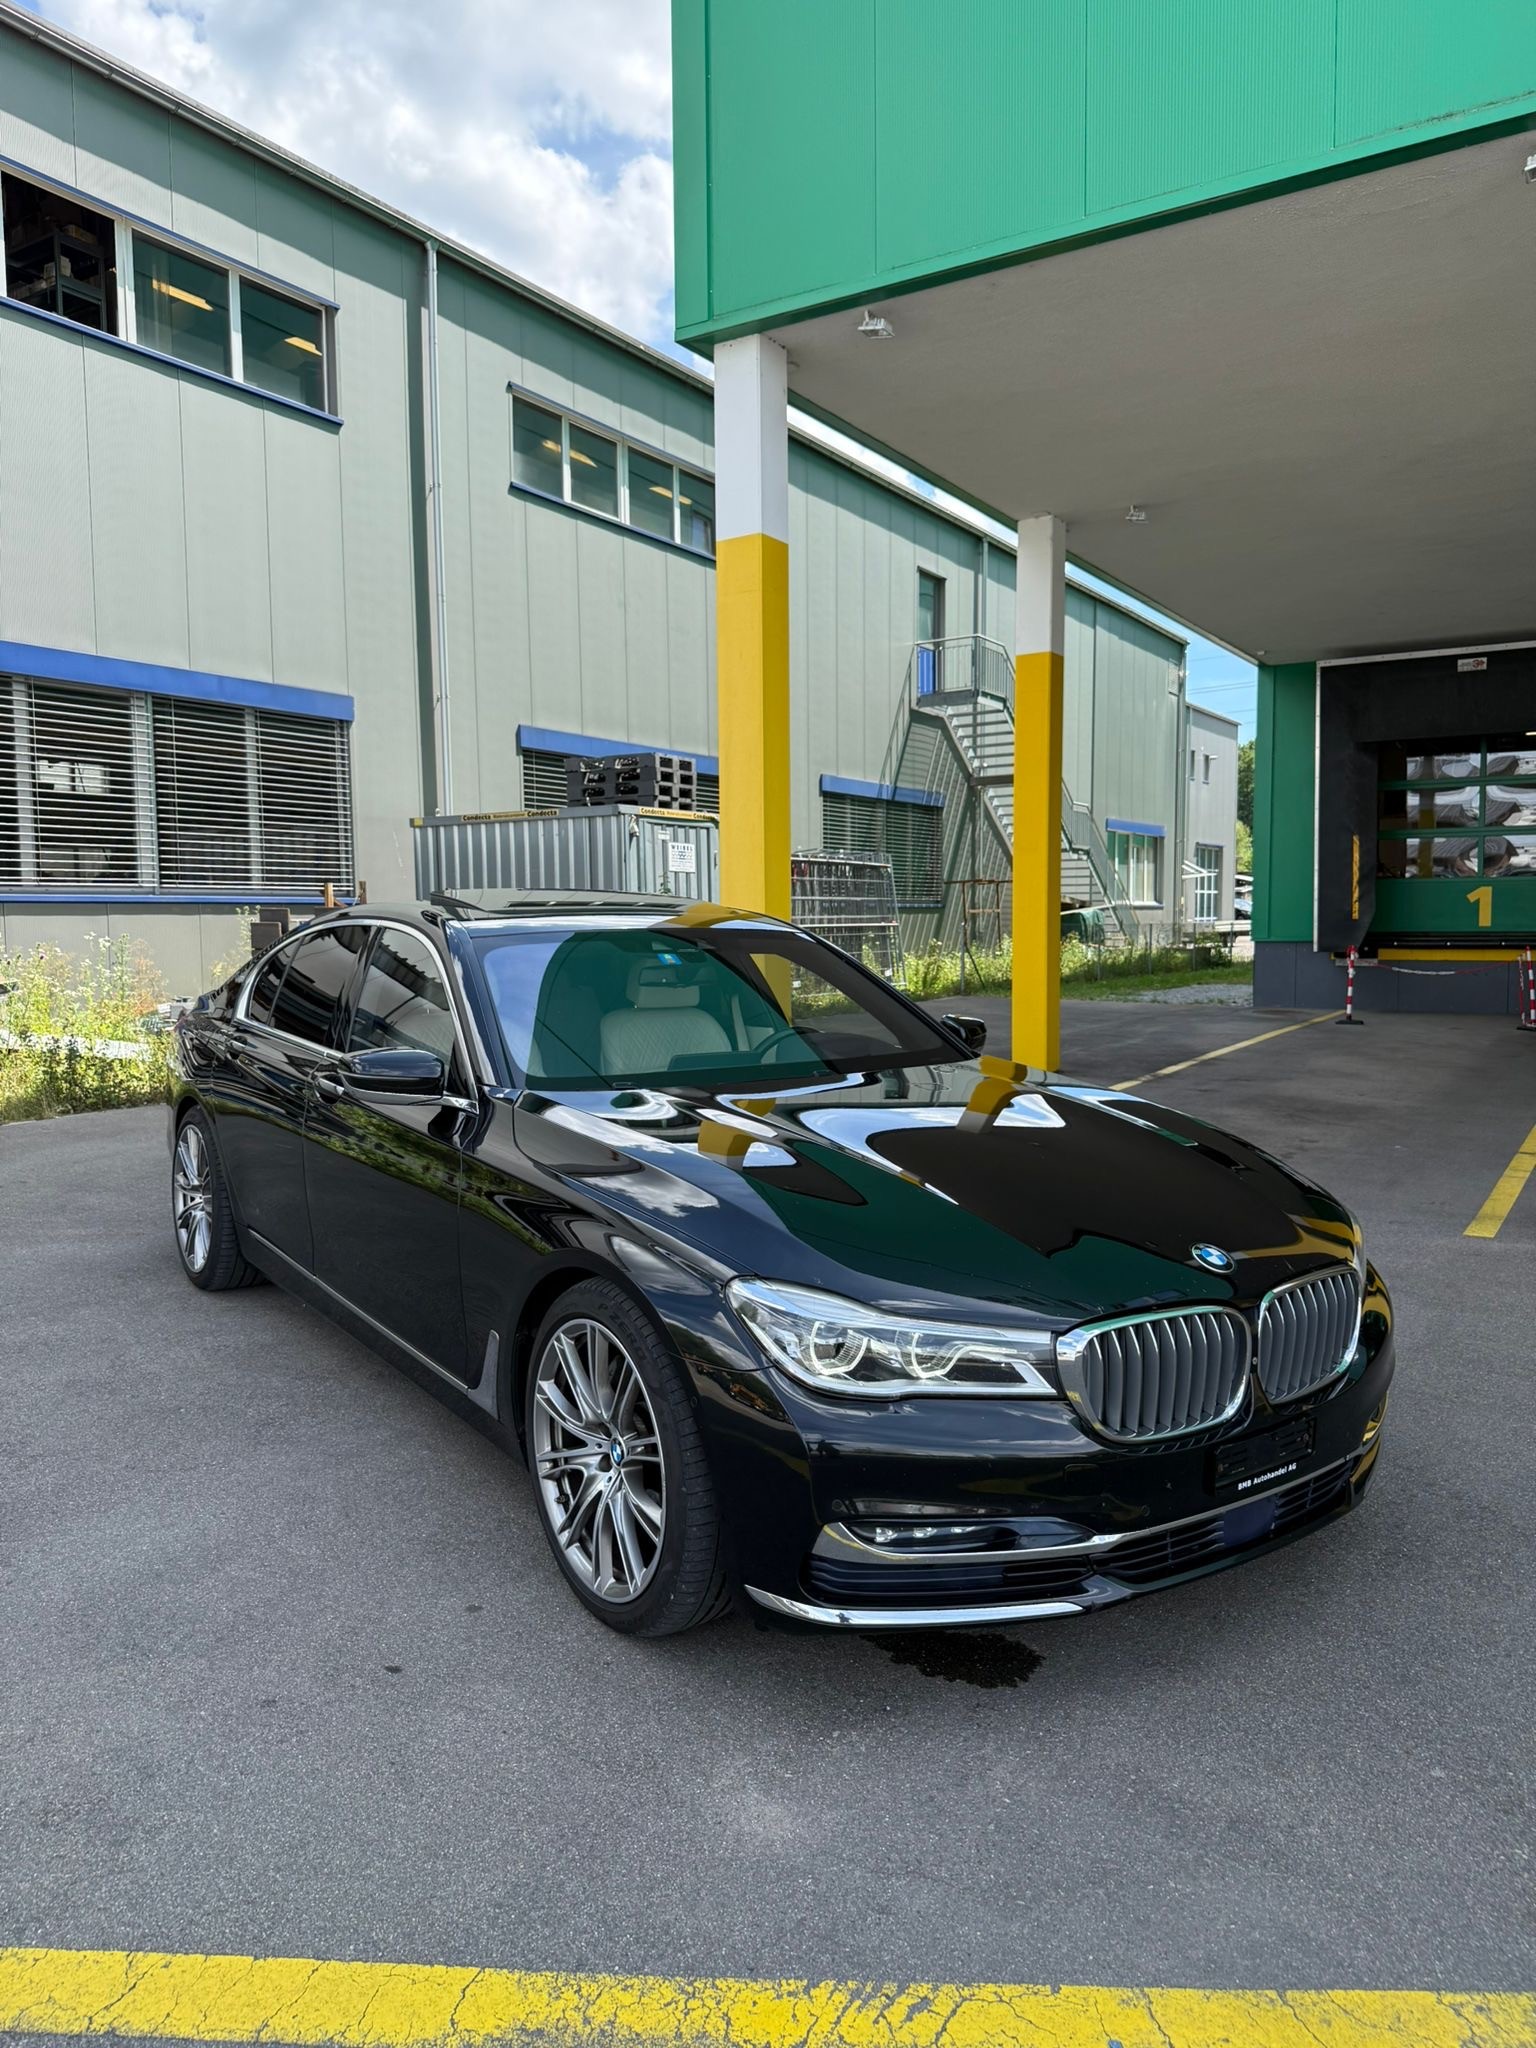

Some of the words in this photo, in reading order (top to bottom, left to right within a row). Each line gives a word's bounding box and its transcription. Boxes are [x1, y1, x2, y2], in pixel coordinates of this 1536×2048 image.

[1466, 886, 1492, 927] 1
[1253, 1466, 1287, 1484] Autohandel
[1288, 1462, 1297, 1471] AG
